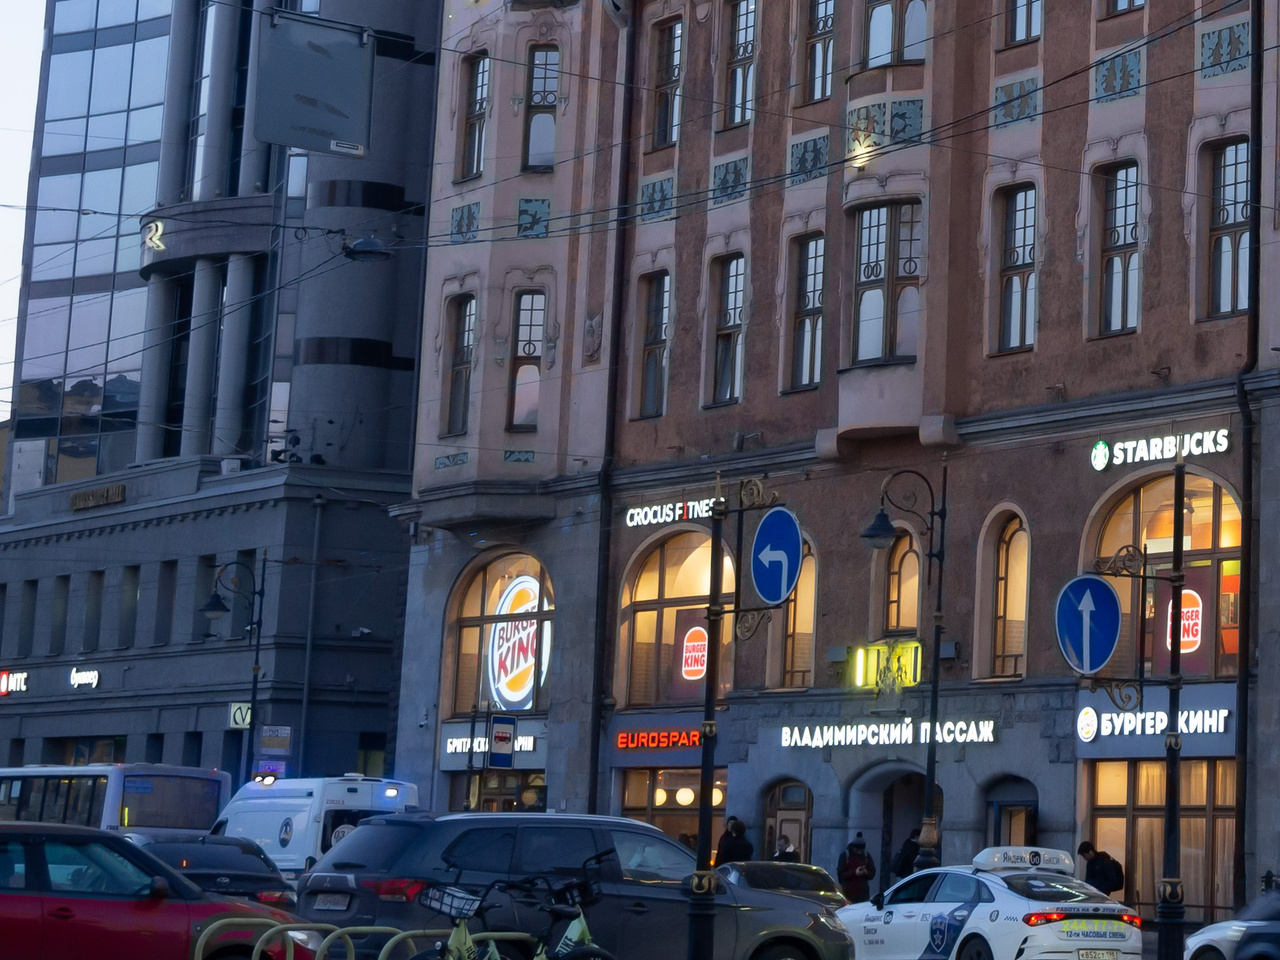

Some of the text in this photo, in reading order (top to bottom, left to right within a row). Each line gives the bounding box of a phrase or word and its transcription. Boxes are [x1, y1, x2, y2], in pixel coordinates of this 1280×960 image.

[1112, 428, 1229, 465] STARBUCKS
[626, 497, 725, 527] CROCUS FITNES
[684, 654, 706, 669] KING
[685, 643, 707, 654] BURGER
[781, 717, 914, 748] ВЛАДИМИРСКИЙ
[1100, 709, 1230, 736] БУРГЕР КИНГ
[617, 730, 701, 748] EUROSPAR
